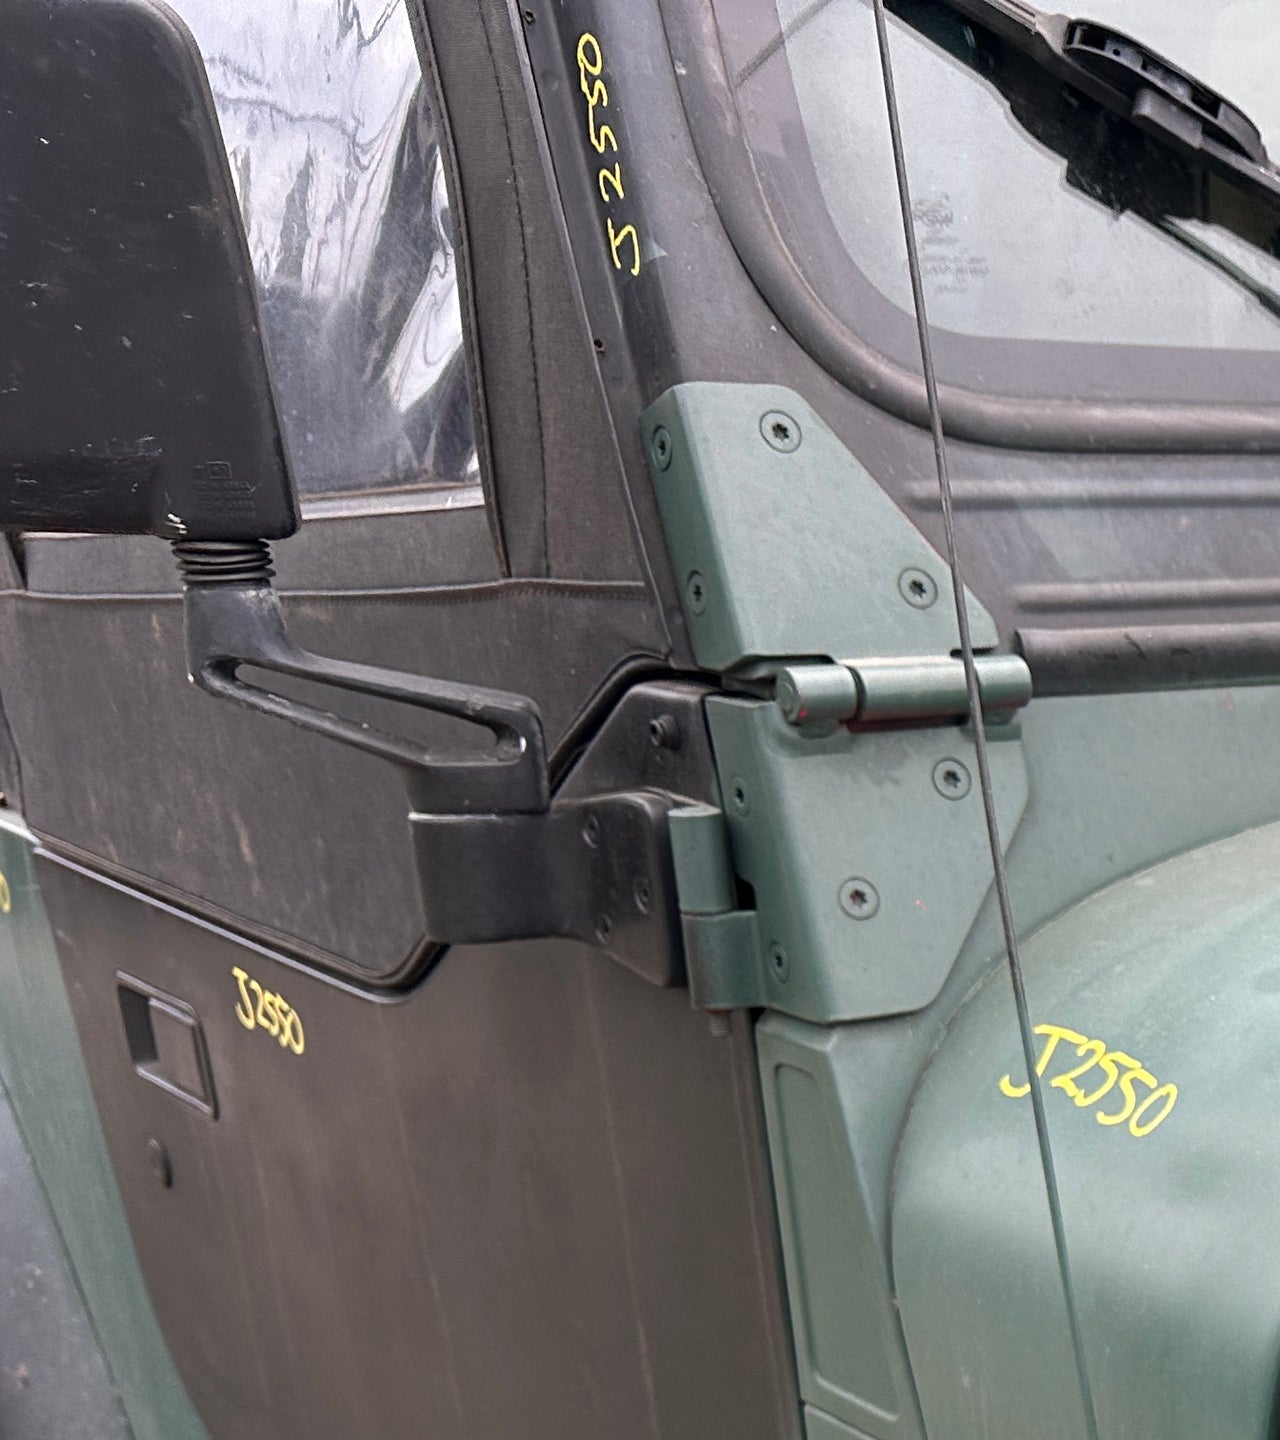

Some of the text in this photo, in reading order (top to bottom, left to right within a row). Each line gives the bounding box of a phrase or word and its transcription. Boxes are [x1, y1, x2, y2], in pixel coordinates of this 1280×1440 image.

[576, 32, 641, 275] J2550
[231, 965, 306, 1056] J2550
[999, 1023, 1178, 1138] J2550
